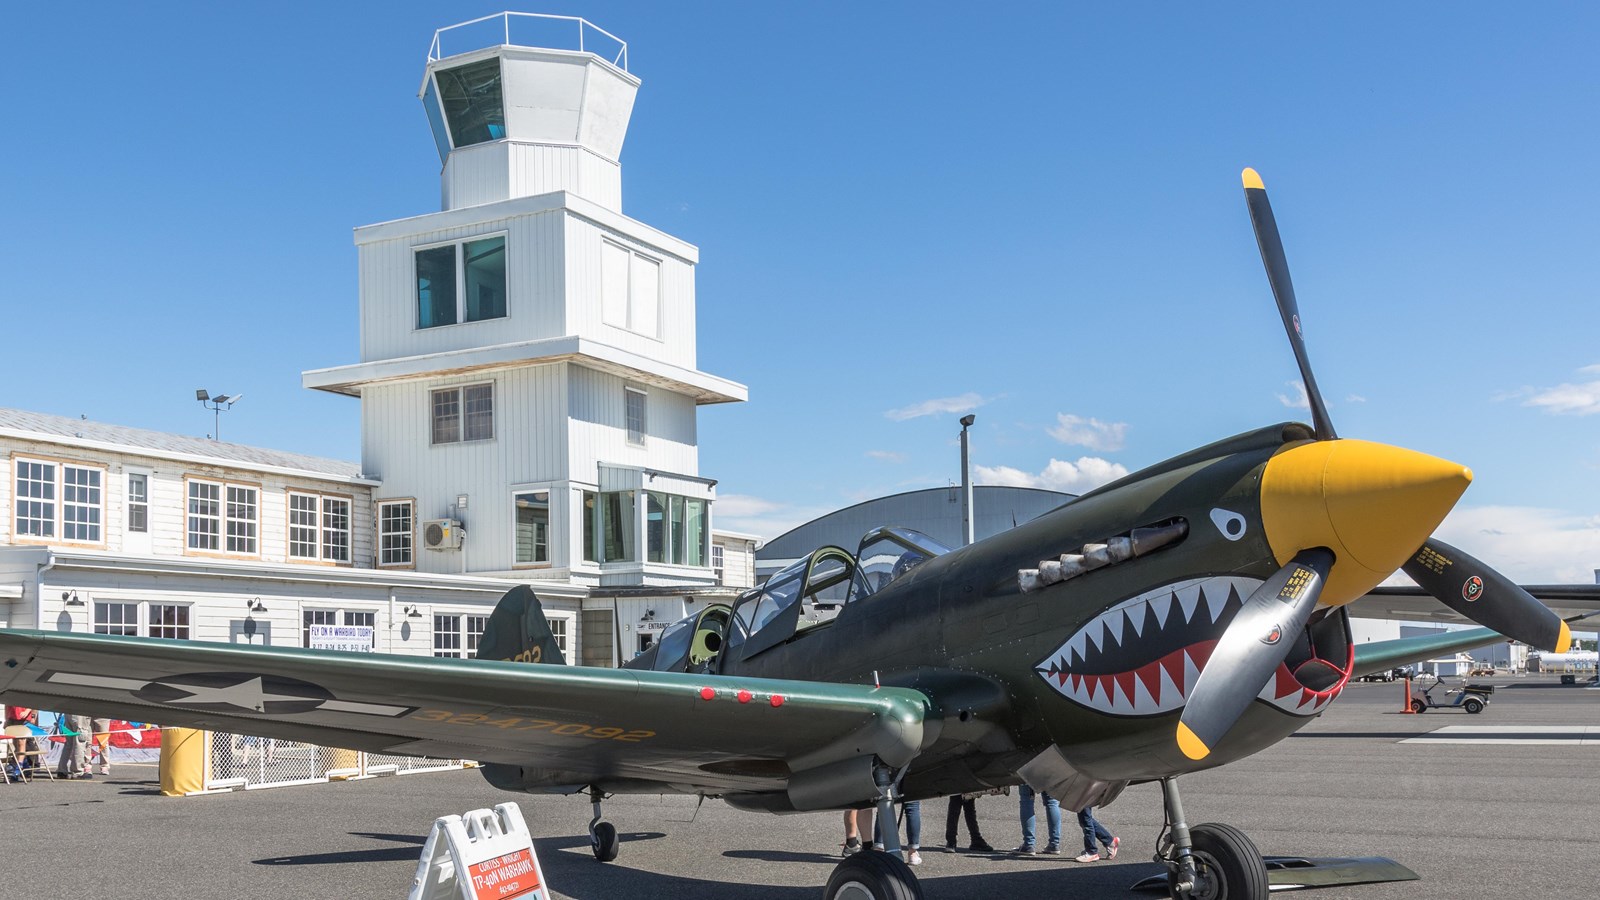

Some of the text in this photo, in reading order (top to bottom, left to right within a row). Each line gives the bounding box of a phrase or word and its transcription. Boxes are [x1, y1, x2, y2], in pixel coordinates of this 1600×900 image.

[321, 627, 328, 636] ON
[329, 627, 333, 636] A
[334, 627, 356, 637] WARBIRD
[412, 710, 656, 741] 3247092
[473, 859, 533, 890] TP-40N WARHAWK
[479, 859, 501, 873] CURTISS
